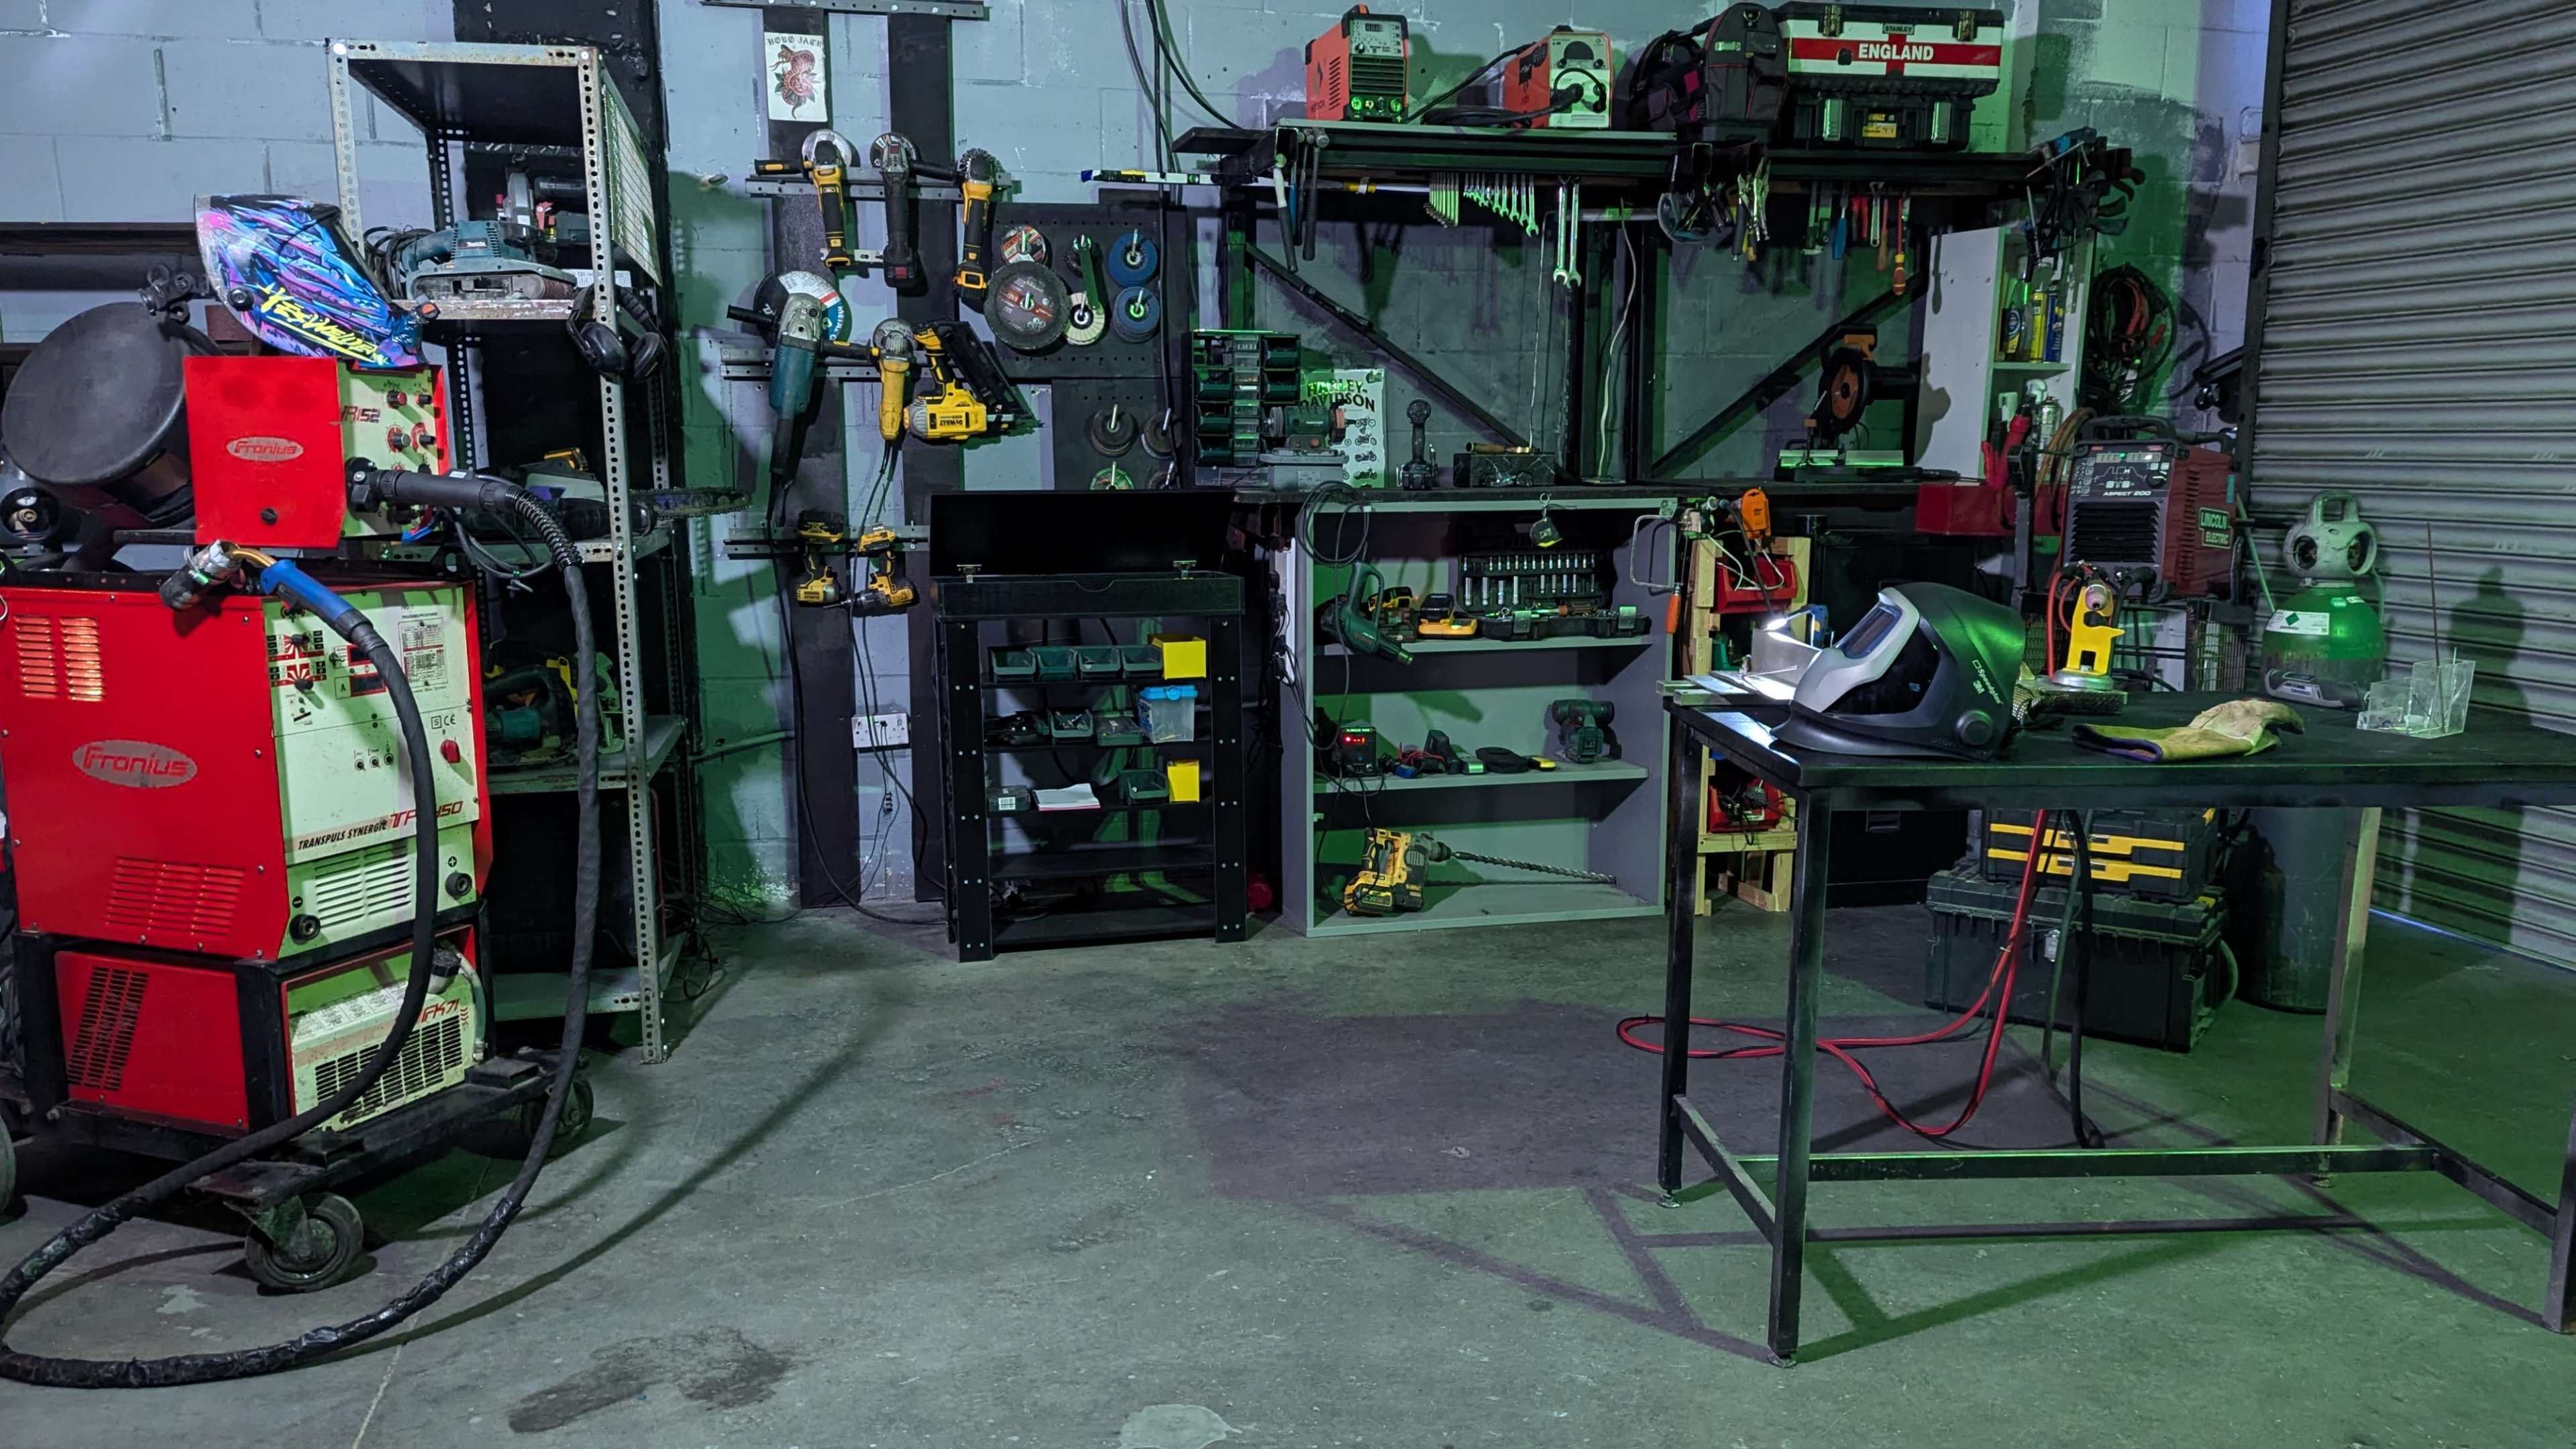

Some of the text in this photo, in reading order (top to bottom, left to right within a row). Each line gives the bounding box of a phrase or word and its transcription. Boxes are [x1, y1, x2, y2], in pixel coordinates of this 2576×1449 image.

[1858, 43, 1934, 61] ENGLAND
[235, 441, 298, 455] Fronius
[2200, 512, 2228, 529] LINCOLN
[2206, 531, 2229, 544] ELECTRIC
[83, 746, 189, 777] Fronius
[298, 831, 346, 850] TRANSPULS
[347, 819, 387, 839] SYNERGIC
